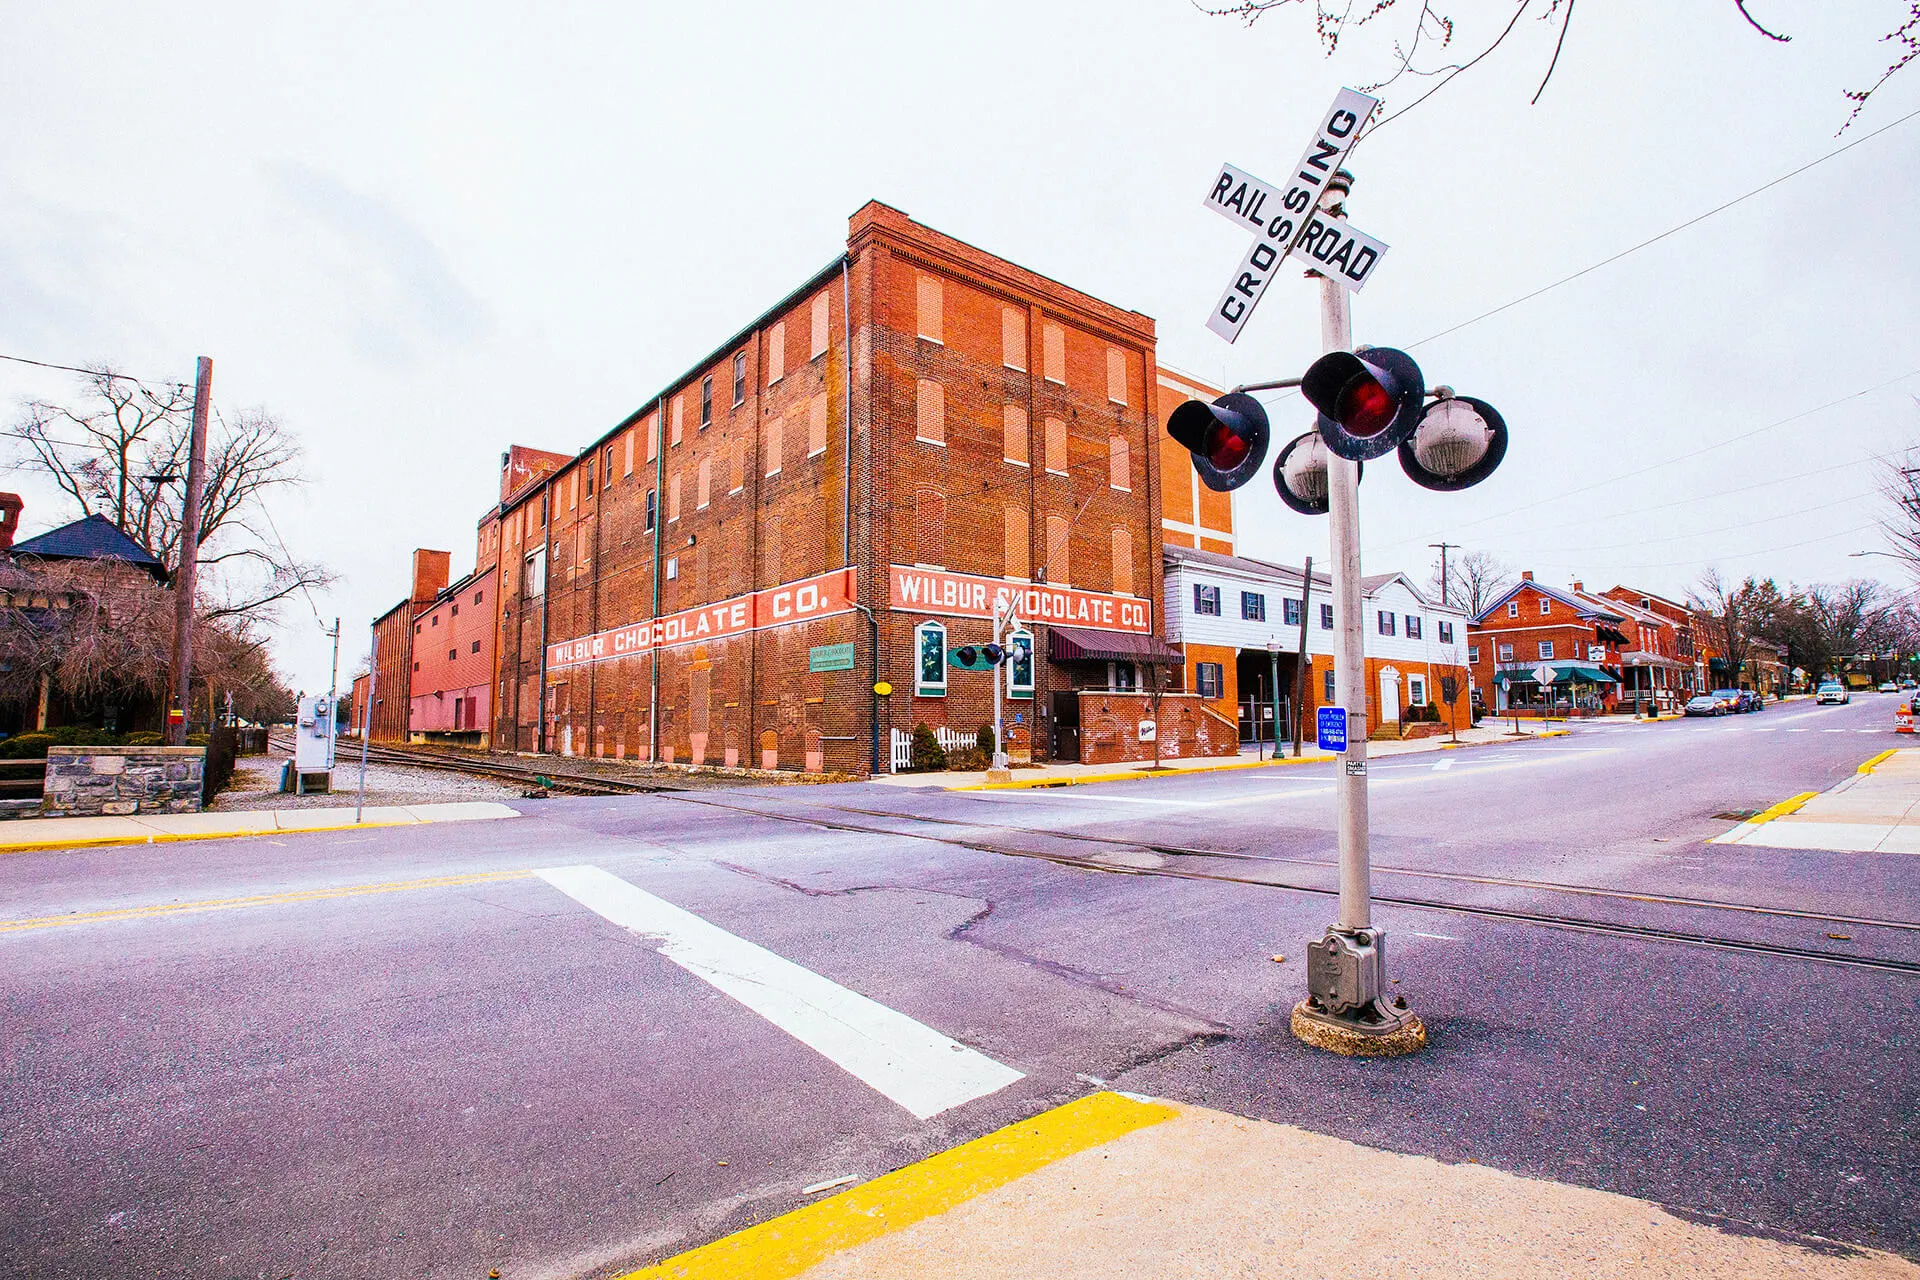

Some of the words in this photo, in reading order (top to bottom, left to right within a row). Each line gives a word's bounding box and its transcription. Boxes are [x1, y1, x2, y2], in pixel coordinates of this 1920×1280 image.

[1210, 173, 1267, 227] RAIL
[1297, 219, 1378, 281] ROAD
[1220, 109, 1357, 324] CROSSING
[556, 638, 604, 662] WILBUR
[614, 602, 746, 652] CHOCOLATE
[773, 585, 829, 618] CO.
[898, 574, 986, 610] WILBUR
[1121, 602, 1148, 628] CO.
